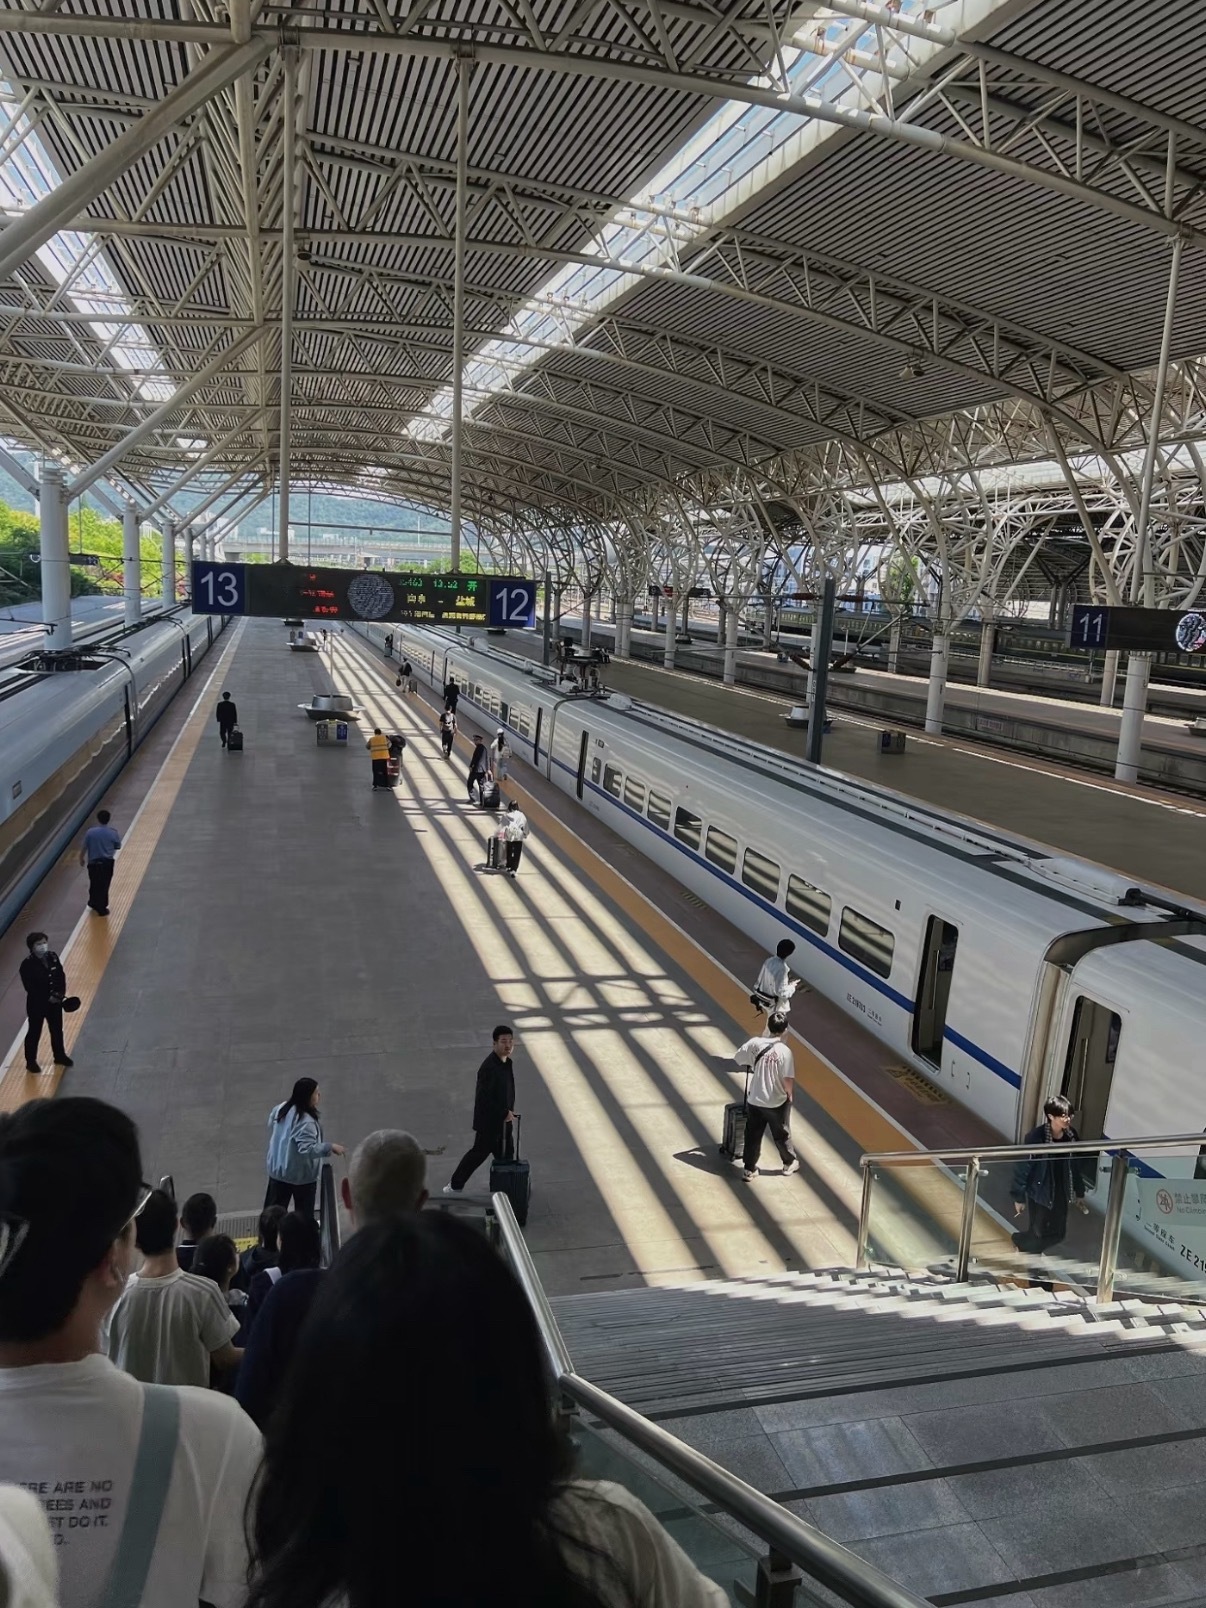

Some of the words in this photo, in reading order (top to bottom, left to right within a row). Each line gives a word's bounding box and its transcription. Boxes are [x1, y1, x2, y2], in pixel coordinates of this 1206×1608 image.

[200, 571, 239, 607] 13
[496, 587, 529, 621] 12
[1080, 612, 1103, 642] 11
[53, 1481, 85, 1494] ARE
[90, 1480, 113, 1492] NO
[79, 1498, 112, 1510] AND
[68, 1515, 90, 1529] DO
